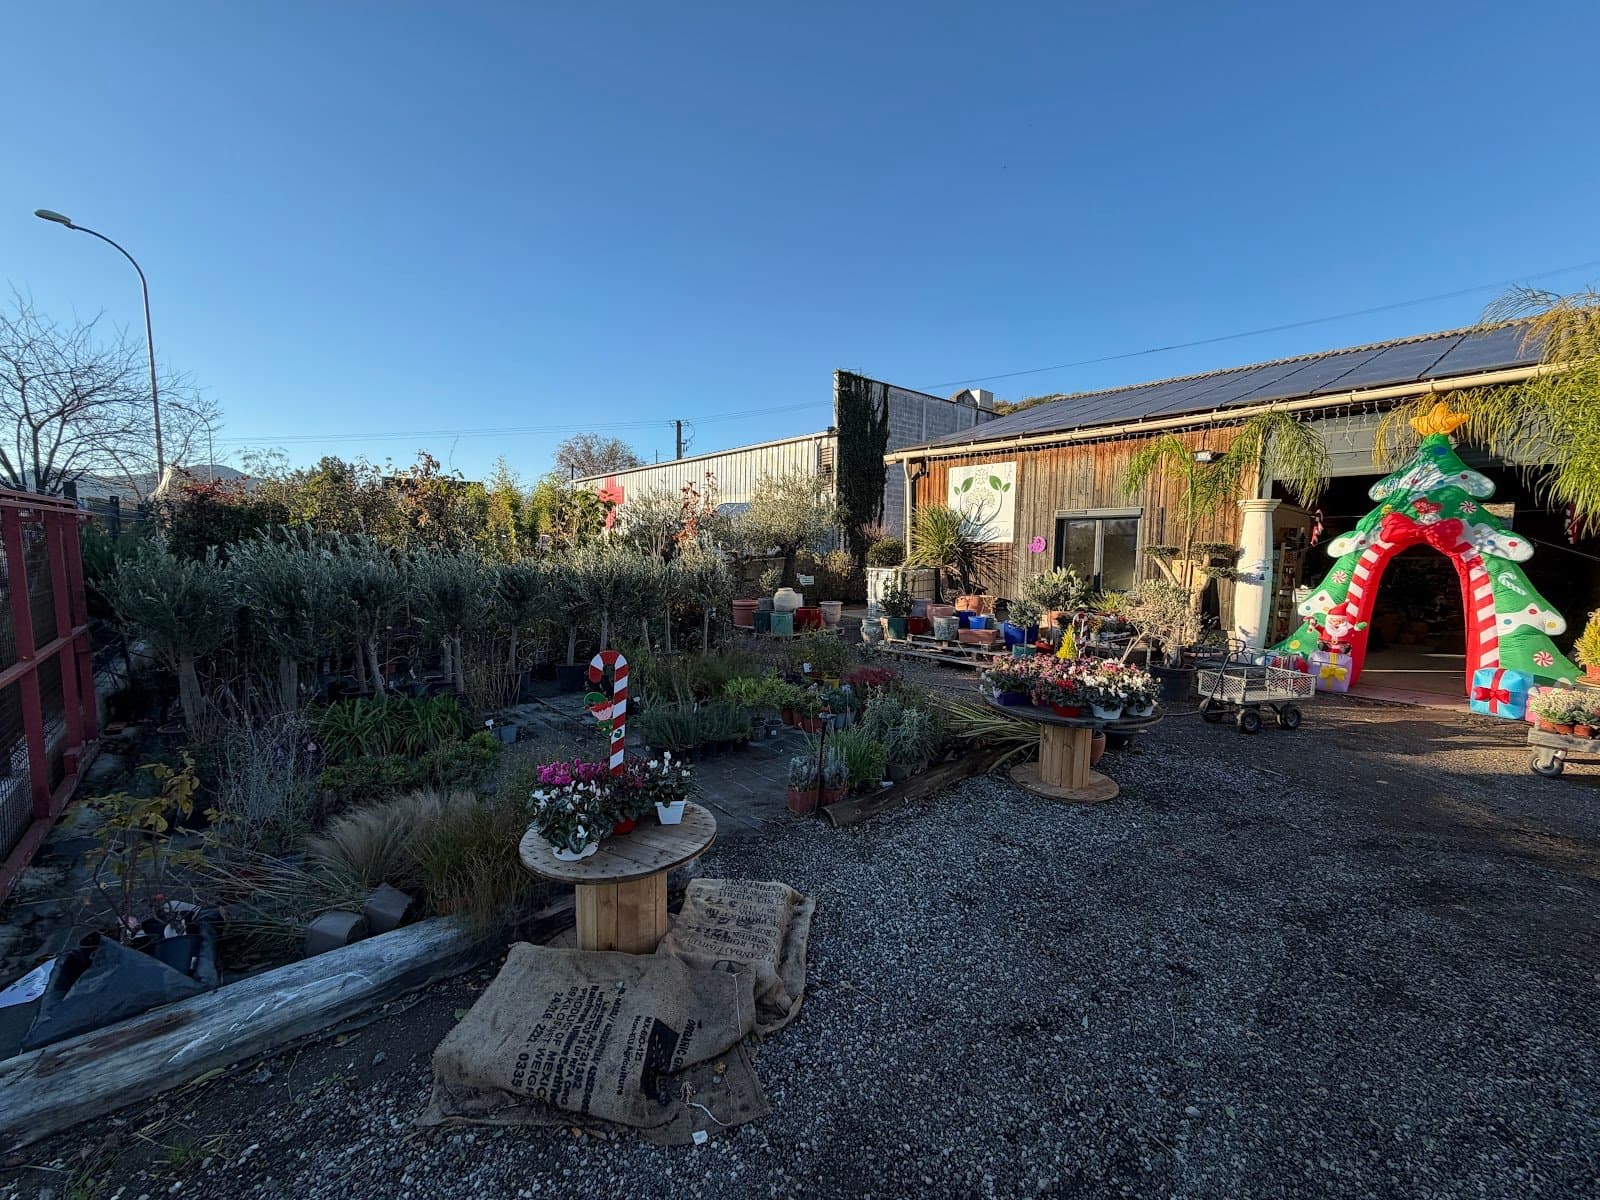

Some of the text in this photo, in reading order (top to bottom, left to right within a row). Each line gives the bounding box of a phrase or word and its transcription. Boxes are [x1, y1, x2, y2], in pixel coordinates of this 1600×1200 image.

[552, 1031, 564, 1047] OF
[676, 1018, 696, 1056] ORGANIC
[510, 1051, 529, 1087] 0335
[616, 1044, 632, 1096] Agriculture
